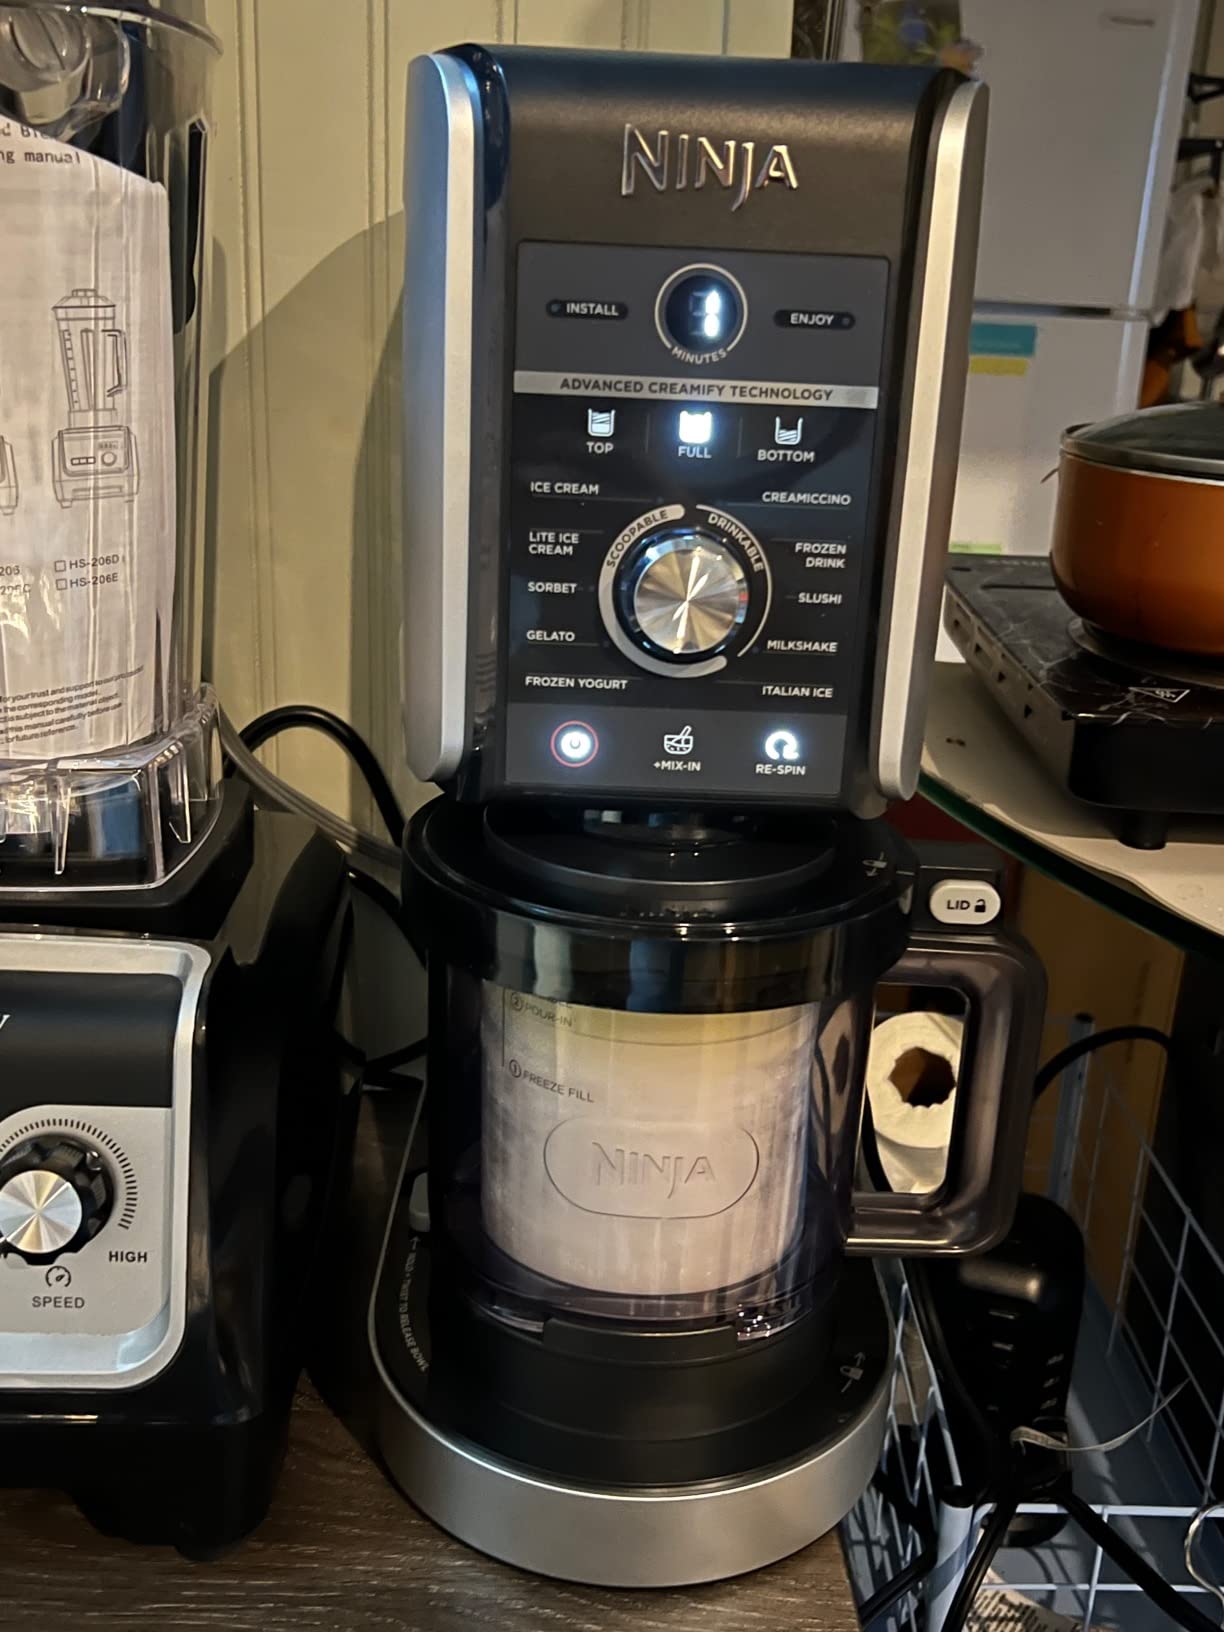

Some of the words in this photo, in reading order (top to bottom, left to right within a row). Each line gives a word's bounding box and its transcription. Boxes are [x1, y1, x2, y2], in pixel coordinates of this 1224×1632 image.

[24, 151, 80, 163] manual
[621, 123, 799, 212] NINJA
[566, 302, 619, 317] INSTALL
[704, 289, 720, 338] 1
[790, 312, 834, 326] ENJOY
[672, 346, 727, 365] MINUTES
[560, 378, 644, 393] ADVANCED
[648, 381, 725, 397] CREAMIFY
[731, 385, 834, 401] TECHNOLOGY
[586, 441, 614, 455] TOP
[678, 446, 712, 459] FULL
[757, 449, 815, 463] BOTTOM
[530, 481, 551, 493] ICE
[554, 482, 599, 495] CREAM
[762, 491, 851, 505] CREAMICCINO
[529, 531, 555, 543] LITE
[559, 532, 579, 544] ICE
[606, 509, 668, 568] SCOOPABLE
[707, 512, 764, 573] DRINKABLE
[528, 544, 573, 556] CREAM
[795, 542, 847, 555] FROZEN
[69, 554, 120, 569] HS-206D
[805, 557, 846, 569] DRINK
[70, 572, 119, 588] HS-206E
[527, 582, 577, 594] SORBET
[798, 592, 842, 604] SLUSHI
[526, 630, 576, 642] GELATO
[767, 640, 838, 652] MILKSHAKE
[525, 676, 575, 688] FROZEN
[578, 678, 628, 690] YOGURT
[762, 685, 810, 697] ITALIAN
[813, 687, 834, 698] ICE
[653, 760, 701, 772] +MIX-IN
[755, 763, 806, 775] RE-SPIN
[946, 899, 970, 910] LID
[523, 1070, 565, 1095] FREEZE
[568, 1087, 595, 1103] FILL
[592, 1141, 716, 1199] NINJA
[108, 1250, 148, 1263] HIGH
[32, 1295, 85, 1309] SPEED
[399, 1314, 416, 1347] RELEASE
[410, 1346, 430, 1372] BOWL
